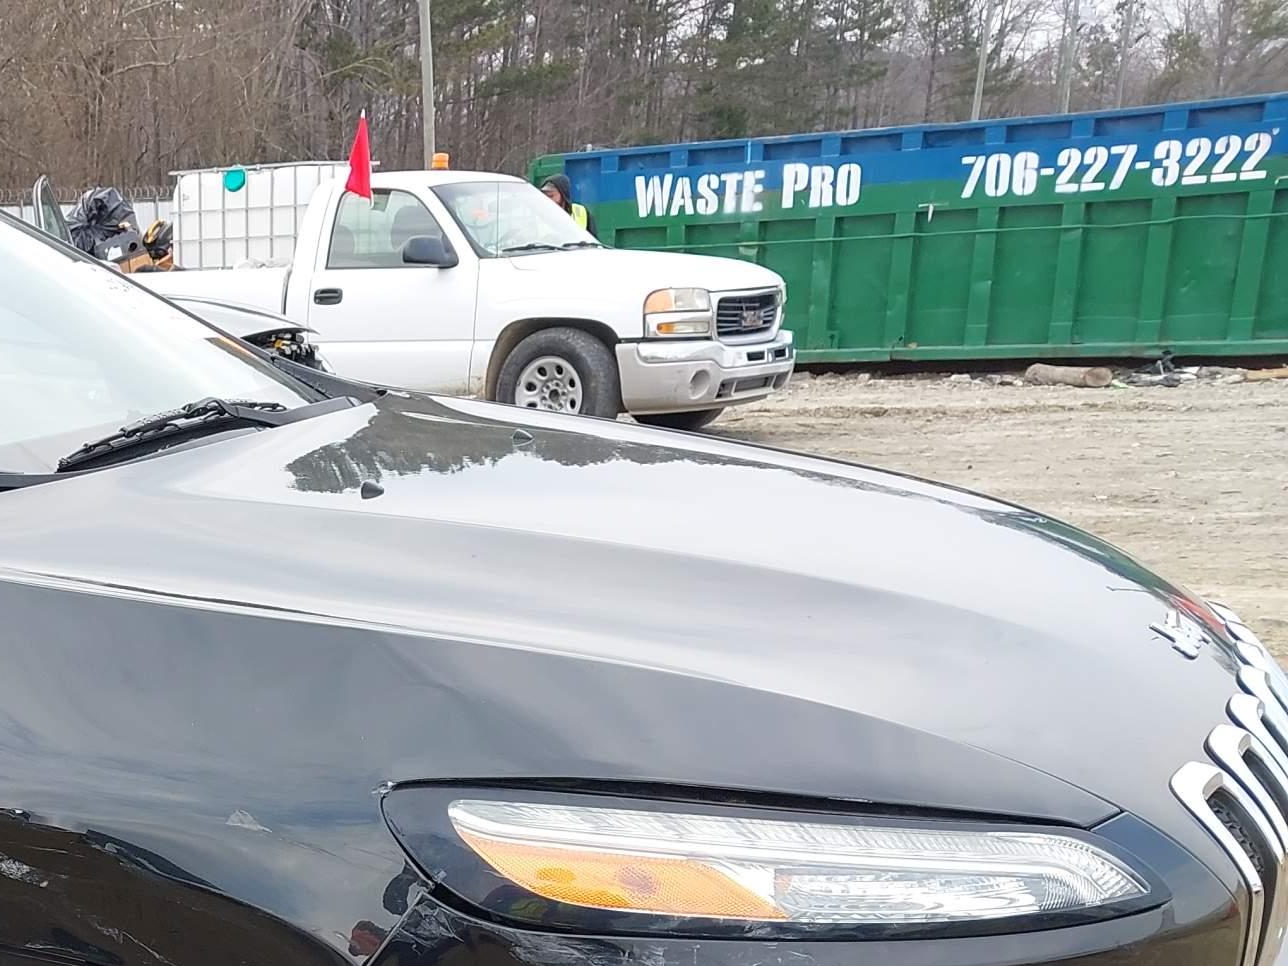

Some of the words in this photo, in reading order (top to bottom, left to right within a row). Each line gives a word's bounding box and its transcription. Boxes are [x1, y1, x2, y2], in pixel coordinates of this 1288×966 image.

[635, 170, 765, 218] WASTE
[781, 163, 862, 209] PRO
[960, 132, 1272, 199] 706-227-3222
